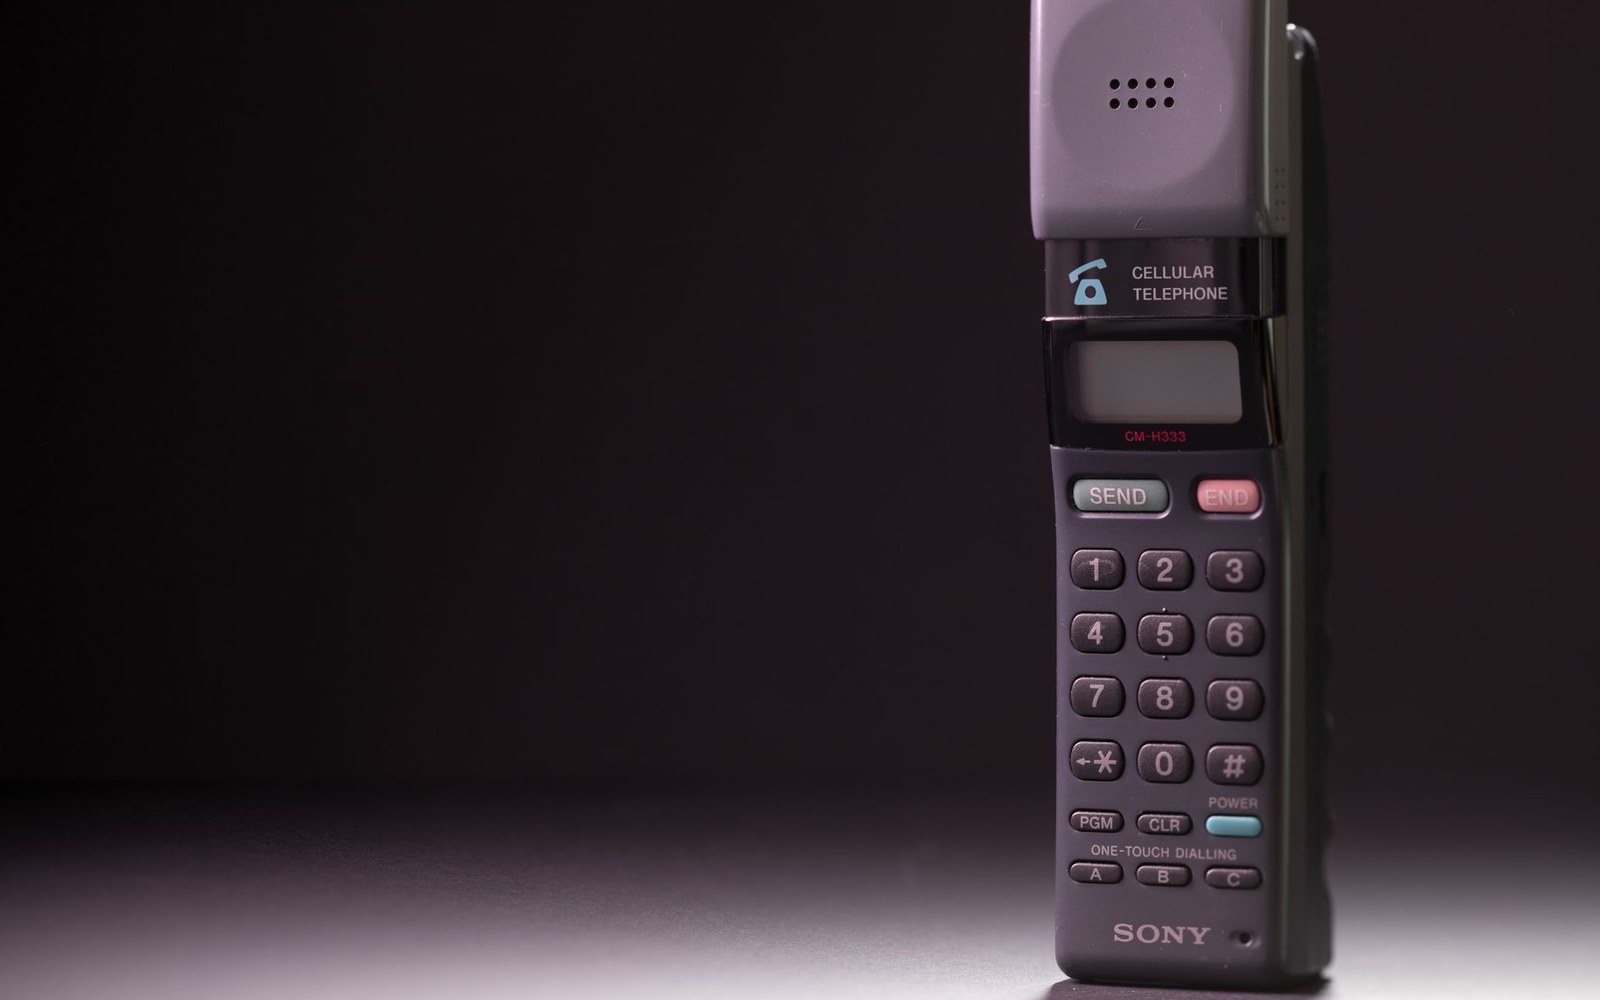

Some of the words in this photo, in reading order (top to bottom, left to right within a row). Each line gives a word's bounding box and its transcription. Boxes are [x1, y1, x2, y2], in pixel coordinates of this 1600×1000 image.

[1132, 266, 1214, 279] CELLULAR
[1133, 287, 1228, 300] TELEPHONE
[1124, 431, 1186, 442] CM-H333
[1090, 487, 1147, 505] SEND
[1204, 488, 1249, 506] END
[1089, 558, 1099, 581] 1
[1156, 557, 1173, 582] 2
[1225, 558, 1244, 584] 3
[1087, 621, 1103, 645] 4
[1156, 622, 1174, 647] 5
[1225, 622, 1244, 648] 6
[1089, 684, 1105, 708] 7
[1156, 685, 1174, 711] 8
[1225, 685, 1244, 711] 9
[1155, 751, 1173, 776] 0
[1209, 797, 1258, 809] POWER
[1080, 816, 1113, 829] PGM
[1149, 818, 1180, 832] CLR
[1091, 844, 1170, 858] ONE-TOUCH
[1175, 847, 1237, 860] DIALLING
[1090, 868, 1102, 880] A
[1157, 870, 1169, 883] B
[1227, 873, 1241, 886] C
[1113, 923, 1212, 945] SONY
